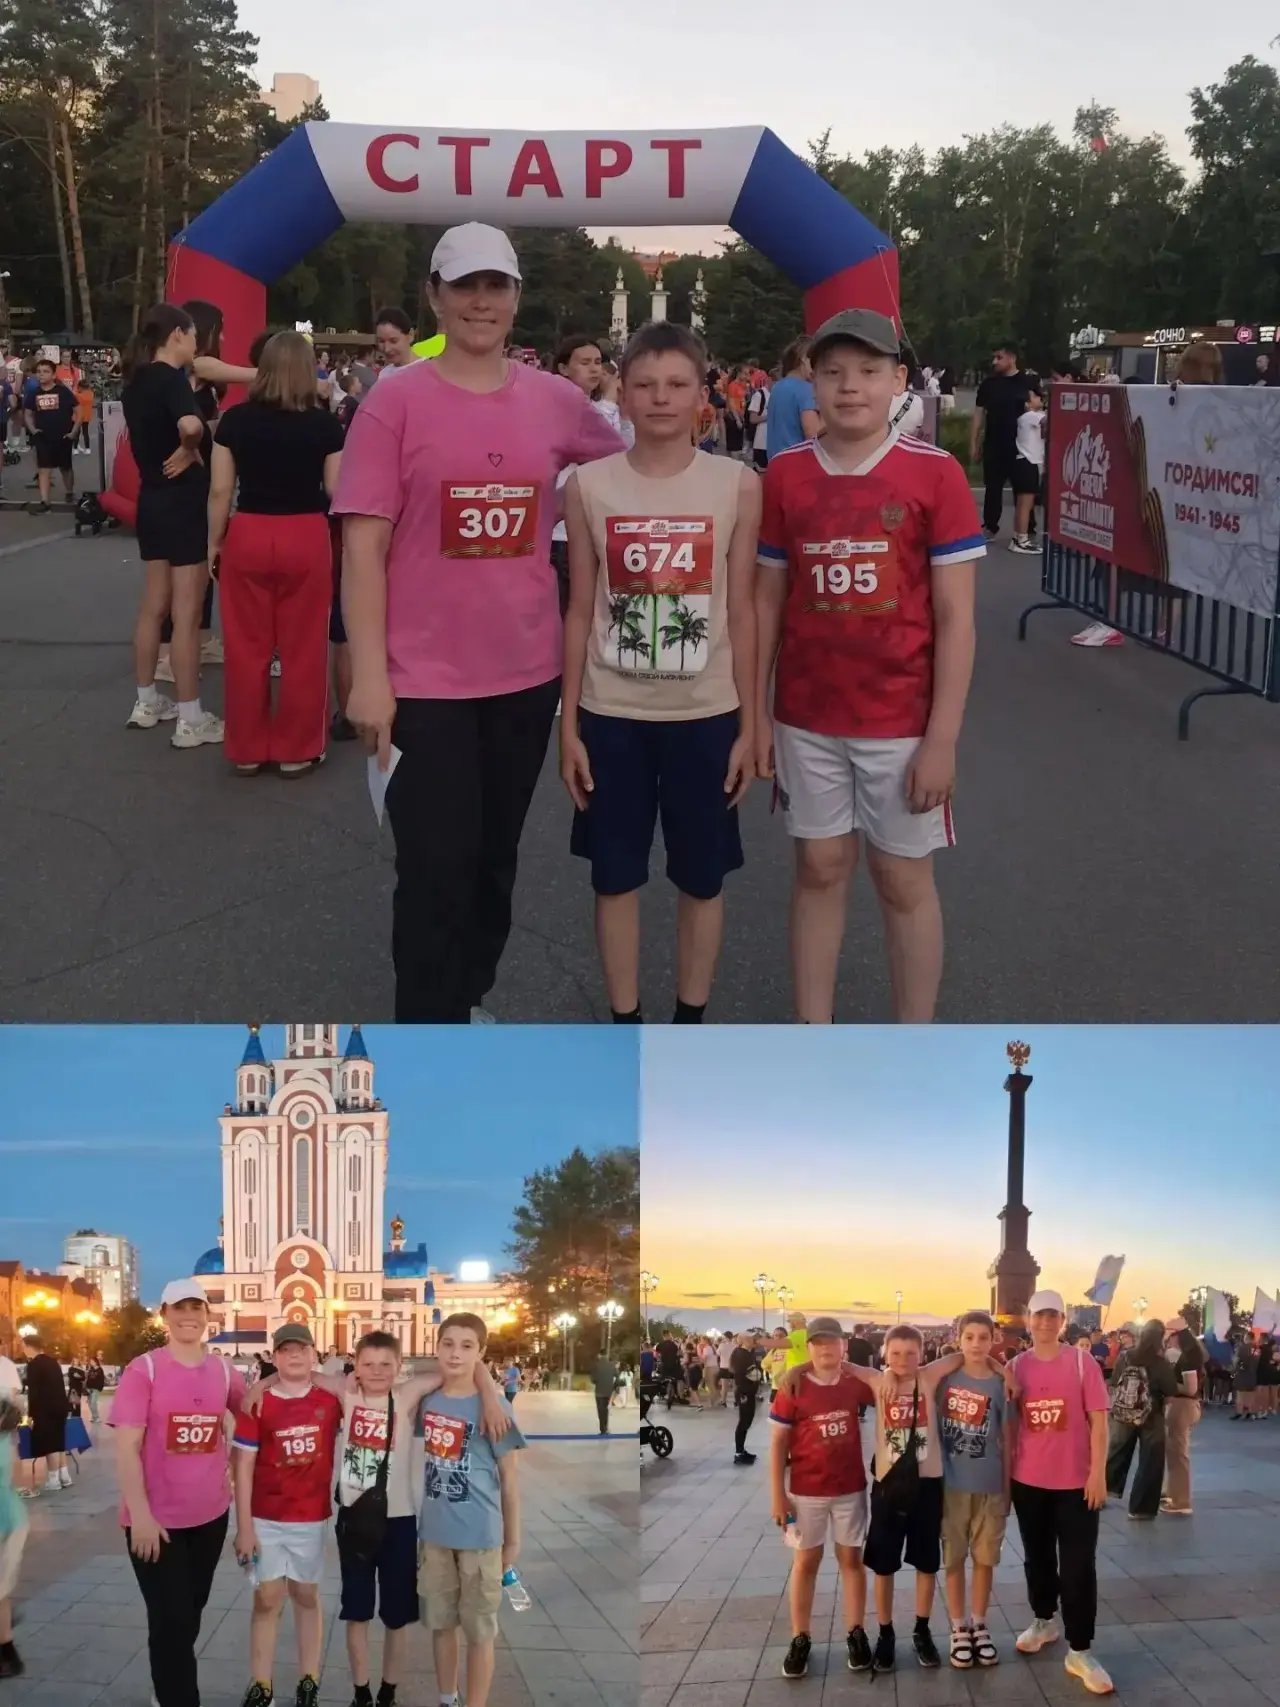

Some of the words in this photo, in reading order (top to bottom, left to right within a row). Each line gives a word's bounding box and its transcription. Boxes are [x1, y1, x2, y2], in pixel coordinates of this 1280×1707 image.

[366, 133, 702, 199] СТАРТ
[1154, 327, 1185, 343] СОЧНО
[1164, 462, 1260, 499] ГОРДИМСЯ!
[458, 507, 527, 539] 307
[623, 542, 697, 574] 674
[811, 563, 879, 595] 195
[948, 1396, 979, 1416] 959
[1031, 1410, 1061, 1425] 307
[176, 1427, 214, 1444] 307
[354, 1420, 387, 1440] 674
[424, 1425, 455, 1448] 959
[818, 1420, 848, 1438] 195
[282, 1437, 317, 1455] 195
